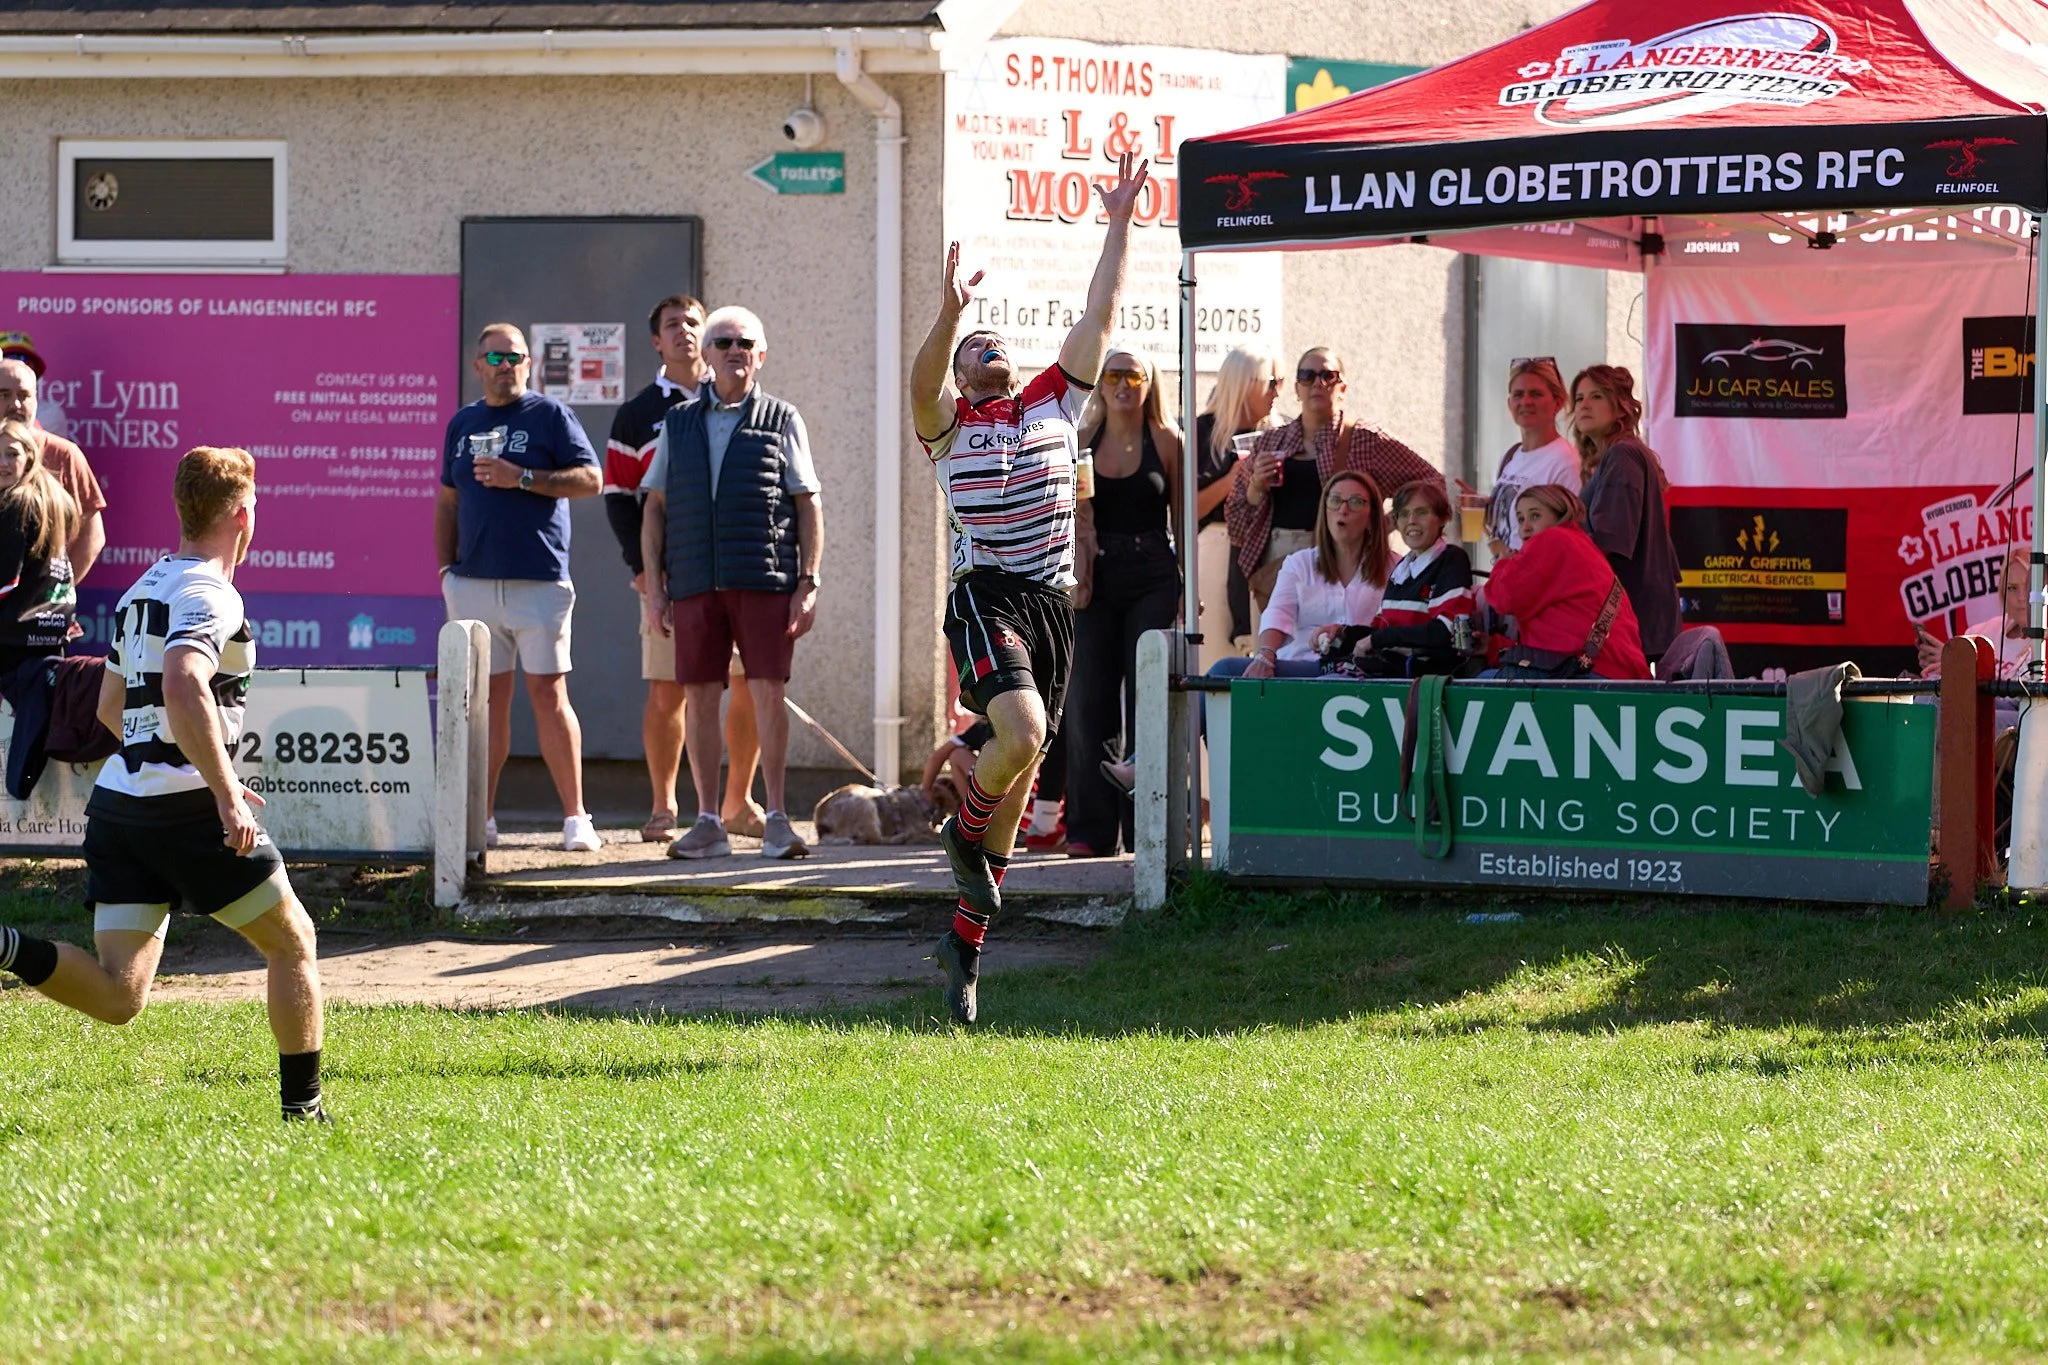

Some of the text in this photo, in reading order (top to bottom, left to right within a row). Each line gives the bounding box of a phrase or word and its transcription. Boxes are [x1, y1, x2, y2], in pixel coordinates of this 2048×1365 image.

[1559, 46, 1839, 76] LLANGENNECH
[1505, 71, 1843, 103] GLOBETROTTERS
[1007, 116, 1048, 137] WHILE
[1062, 110, 1176, 164] L & I
[971, 141, 1034, 161] YOU WAIT
[780, 167, 836, 181] TOILETS
[1304, 148, 1905, 214] LLAN GLOBETROTTERS RFC
[1936, 181, 2000, 194] FELINFOEL
[1216, 214, 1273, 227] FELINFOEL
[18, 297, 377, 317] PROUD SPONSORS OF LLANGENNECH RFC
[974, 297, 1008, 326] Tel
[1017, 307, 1040, 326] or
[1119, 305, 1169, 332] 1554
[1196, 307, 1262, 333] 20765
[1971, 346, 2035, 380] THE Br
[315, 373, 437, 387] CONTACT US FOR A
[1686, 378, 1834, 398] JJ CAR SALES
[37, 370, 180, 419] ter Lynn
[274, 391, 437, 406] FREE INITIAL DISCUSSION
[291, 410, 437, 424] ON ANY LEGAL MATTER
[66, 418, 179, 449] RTNERS
[292, 447, 338, 460] OFFICE
[1945, 498, 1973, 514] CERDDED
[1704, 556, 1812, 571] GARRY GRIFFITHS
[1701, 574, 1815, 587] ELECTRICAL SERVICES
[250, 618, 321, 649] eam
[375, 626, 416, 645] GRS
[274, 731, 410, 765] 882353
[17, 817, 53, 834] Care
[59, 818, 87, 835] Ho
[1338, 791, 1841, 843] BUIDING SOCIETY
[1479, 852, 1682, 883] Established 1923
